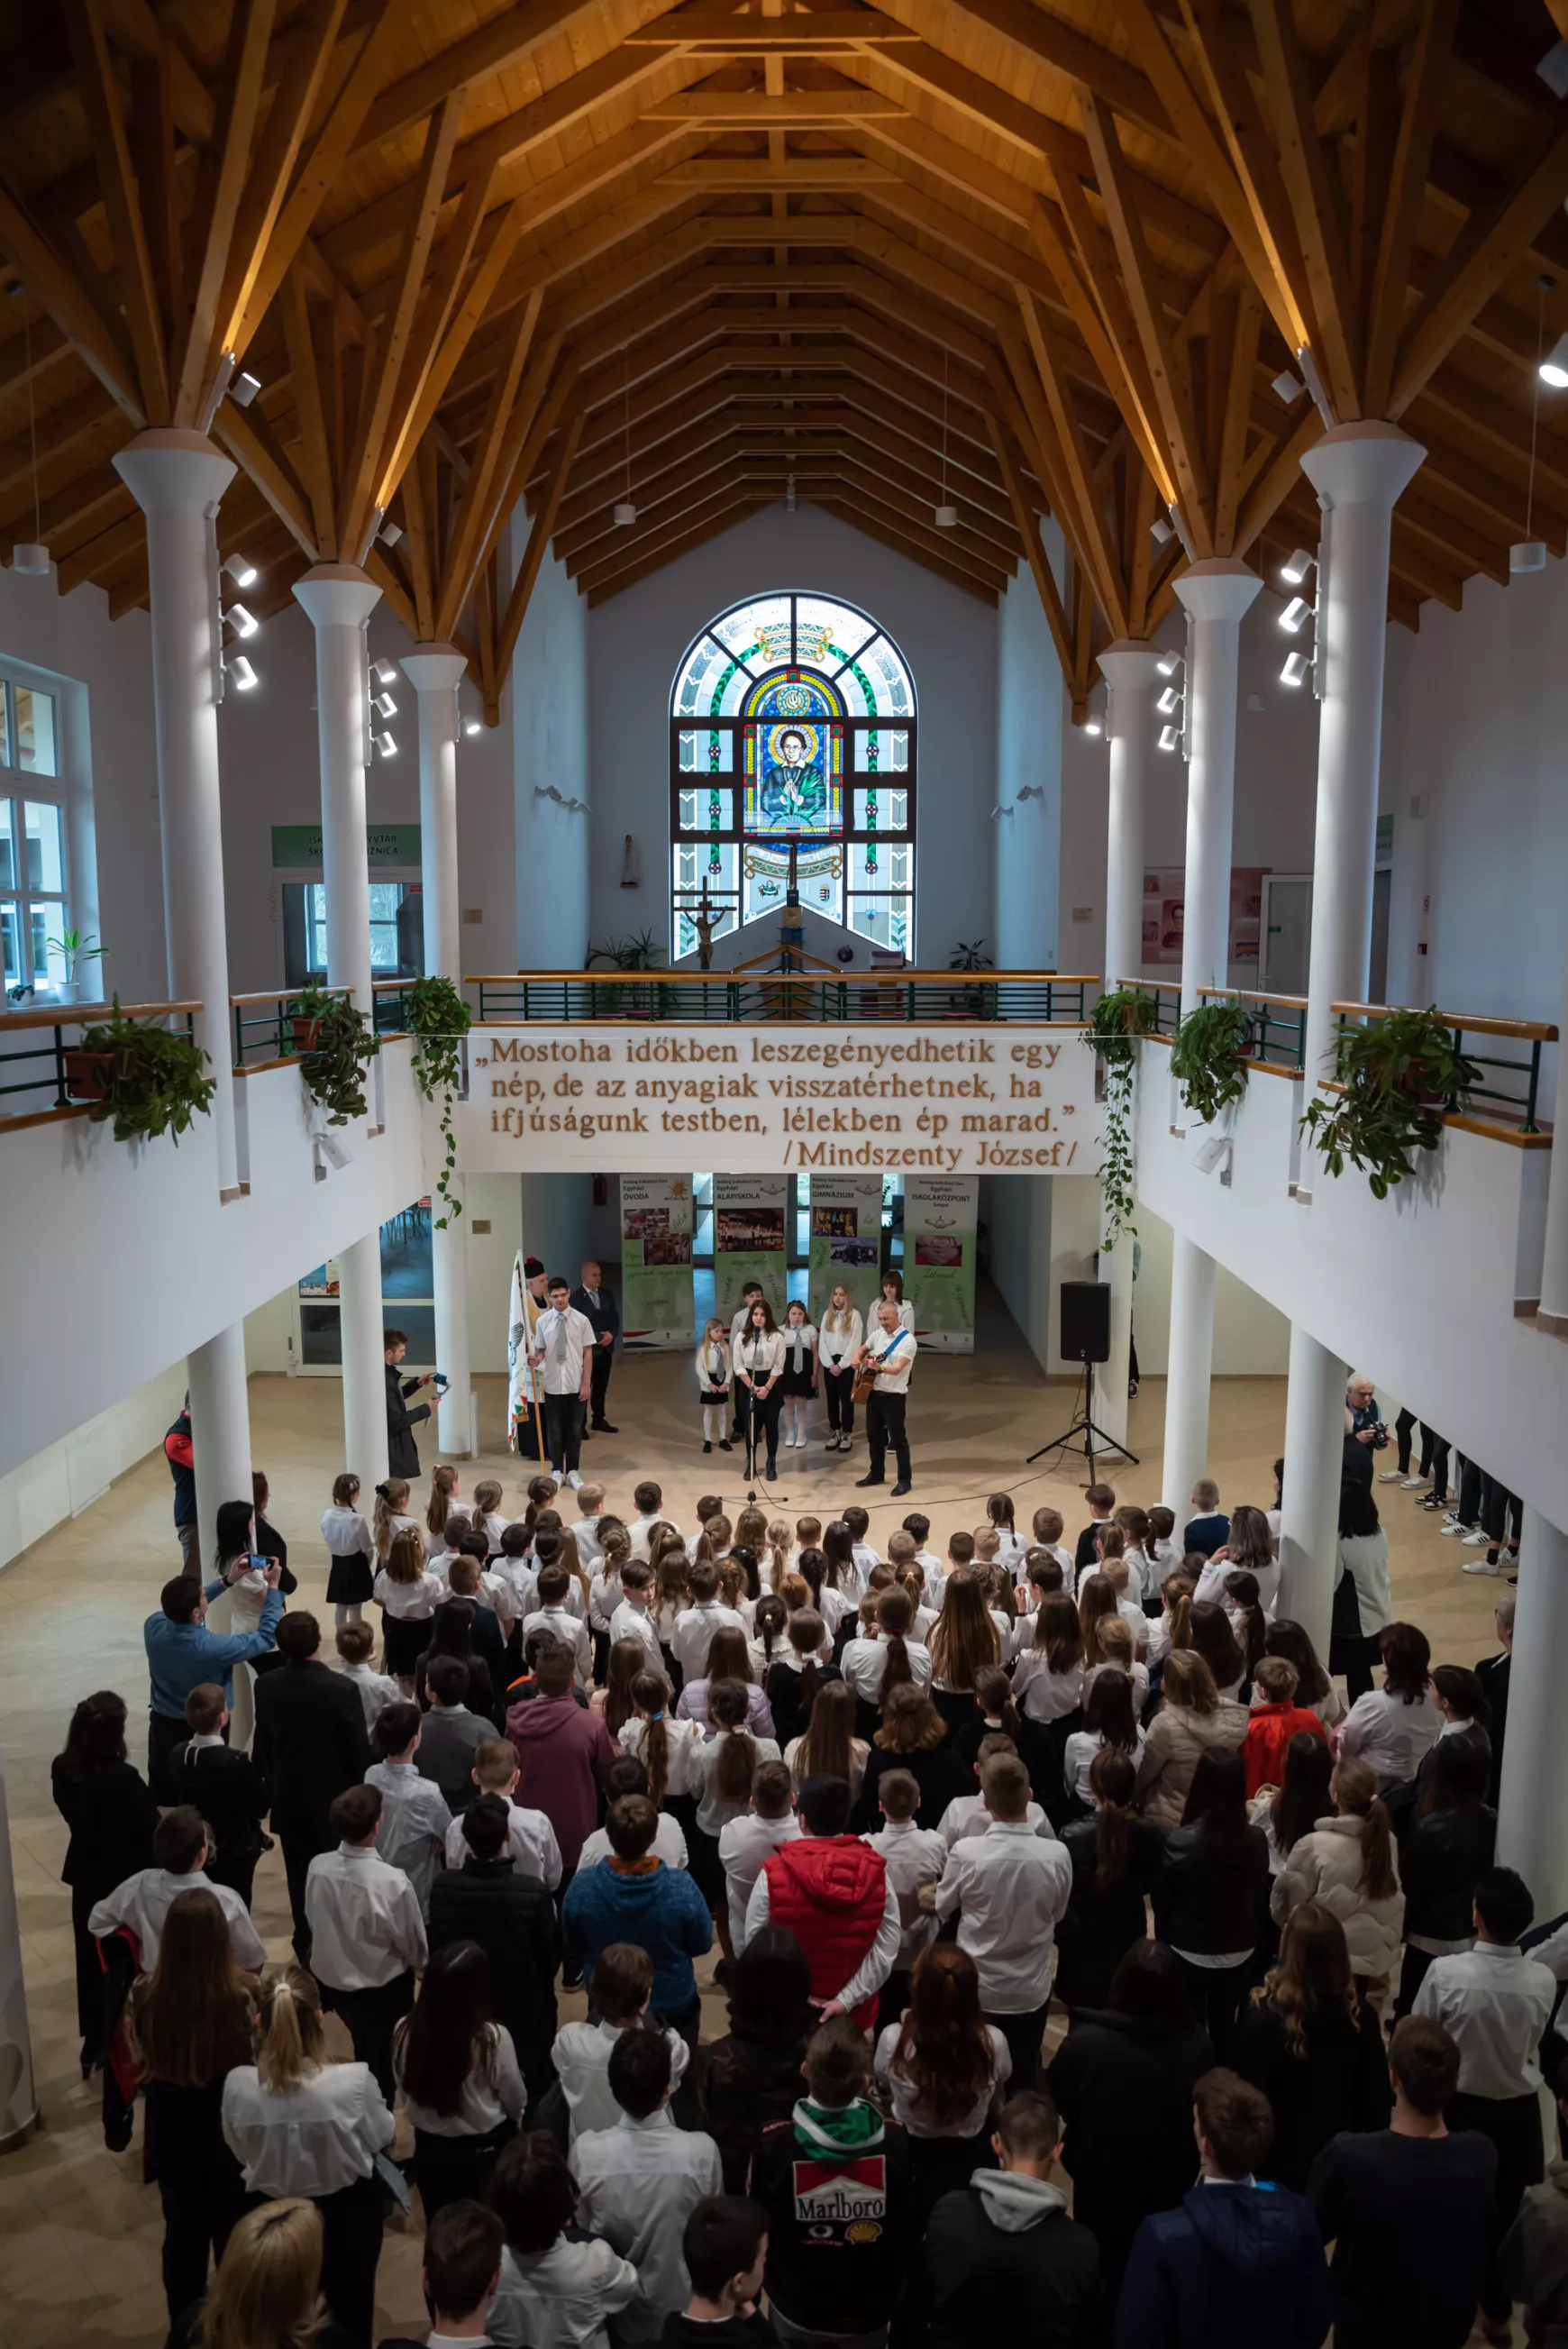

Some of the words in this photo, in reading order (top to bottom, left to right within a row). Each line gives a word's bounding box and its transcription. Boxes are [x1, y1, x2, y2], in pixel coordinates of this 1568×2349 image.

[625, 1037, 739, 1063] időkben
[751, 1036, 995, 1068] leszegényedhetik
[1010, 1043, 1062, 1068] egy
[491, 1071, 546, 1104] nép,
[553, 1072, 584, 1098] de
[596, 1079, 626, 1098] az
[634, 1072, 759, 1104] anyagiak
[767, 1071, 996, 1102] visszatérhetnek,
[1008, 1073, 1043, 1098] ha
[491, 1105, 650, 1138] ifjúságunk
[661, 1107, 768, 1136] testben,
[782, 1106, 903, 1133] lélekben
[916, 1106, 950, 1138] ép
[623, 1192, 650, 1201] ÓVODA
[716, 1193, 761, 1201] ALAPISKOLA
[812, 1190, 855, 1200] GIMNÁZIUM
[912, 1193, 971, 1203] ISKOLAKÖZPONT
[798, 2192, 883, 2220] Marlboro
